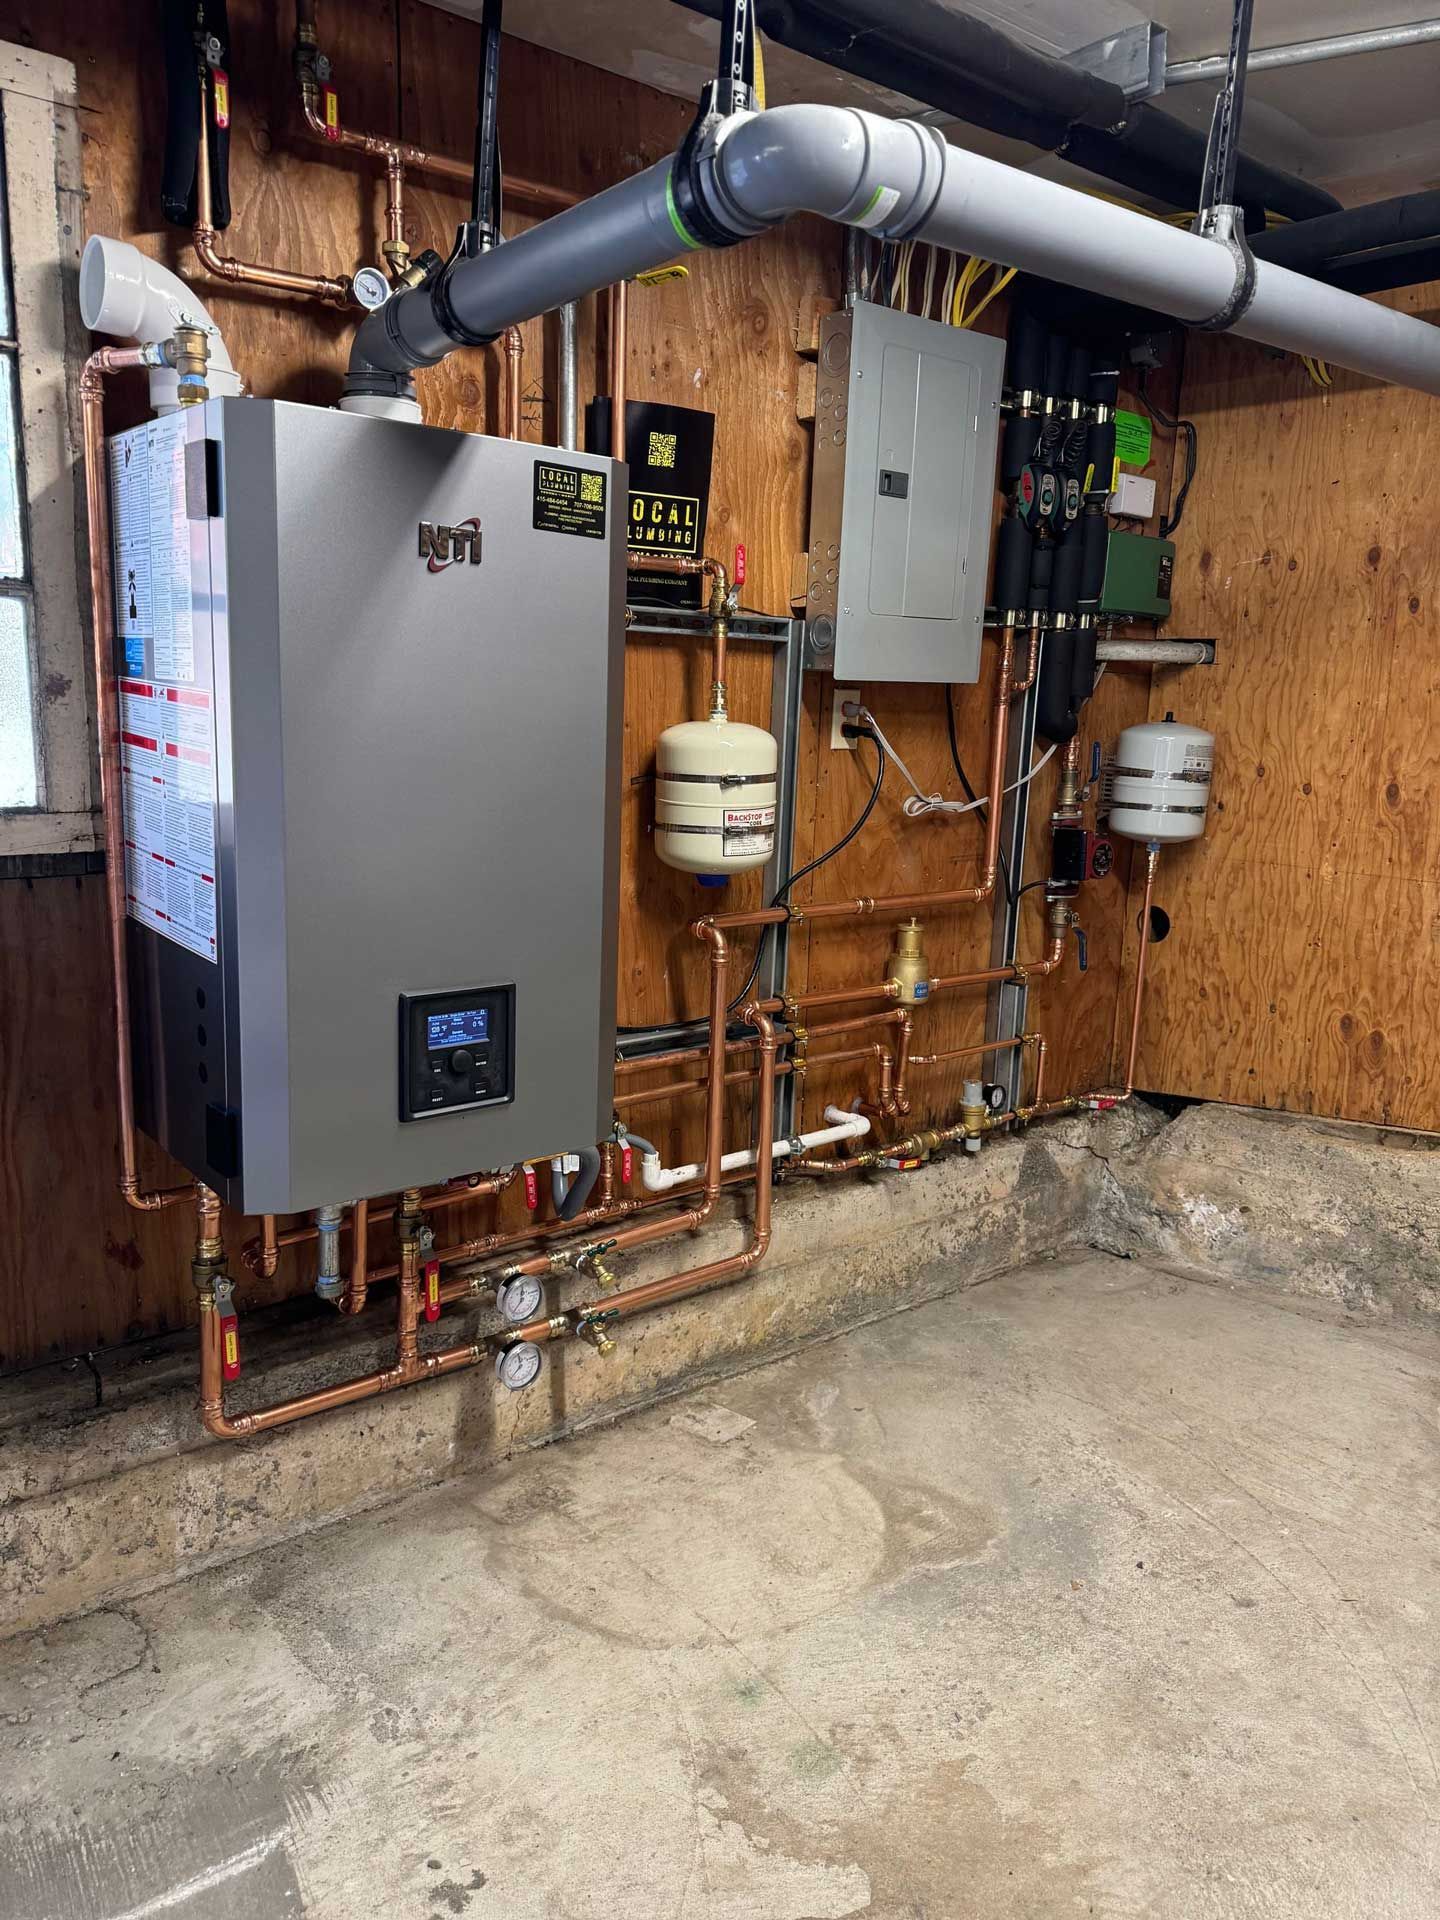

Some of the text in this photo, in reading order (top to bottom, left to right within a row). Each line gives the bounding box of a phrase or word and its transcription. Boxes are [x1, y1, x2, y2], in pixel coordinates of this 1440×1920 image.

[541, 469, 575, 485] LOCAL
[632, 498, 694, 527] OCAL
[418, 521, 483, 565] NTI
[627, 525, 692, 545] LUMBING
[727, 813, 763, 822] BACKSTOP
